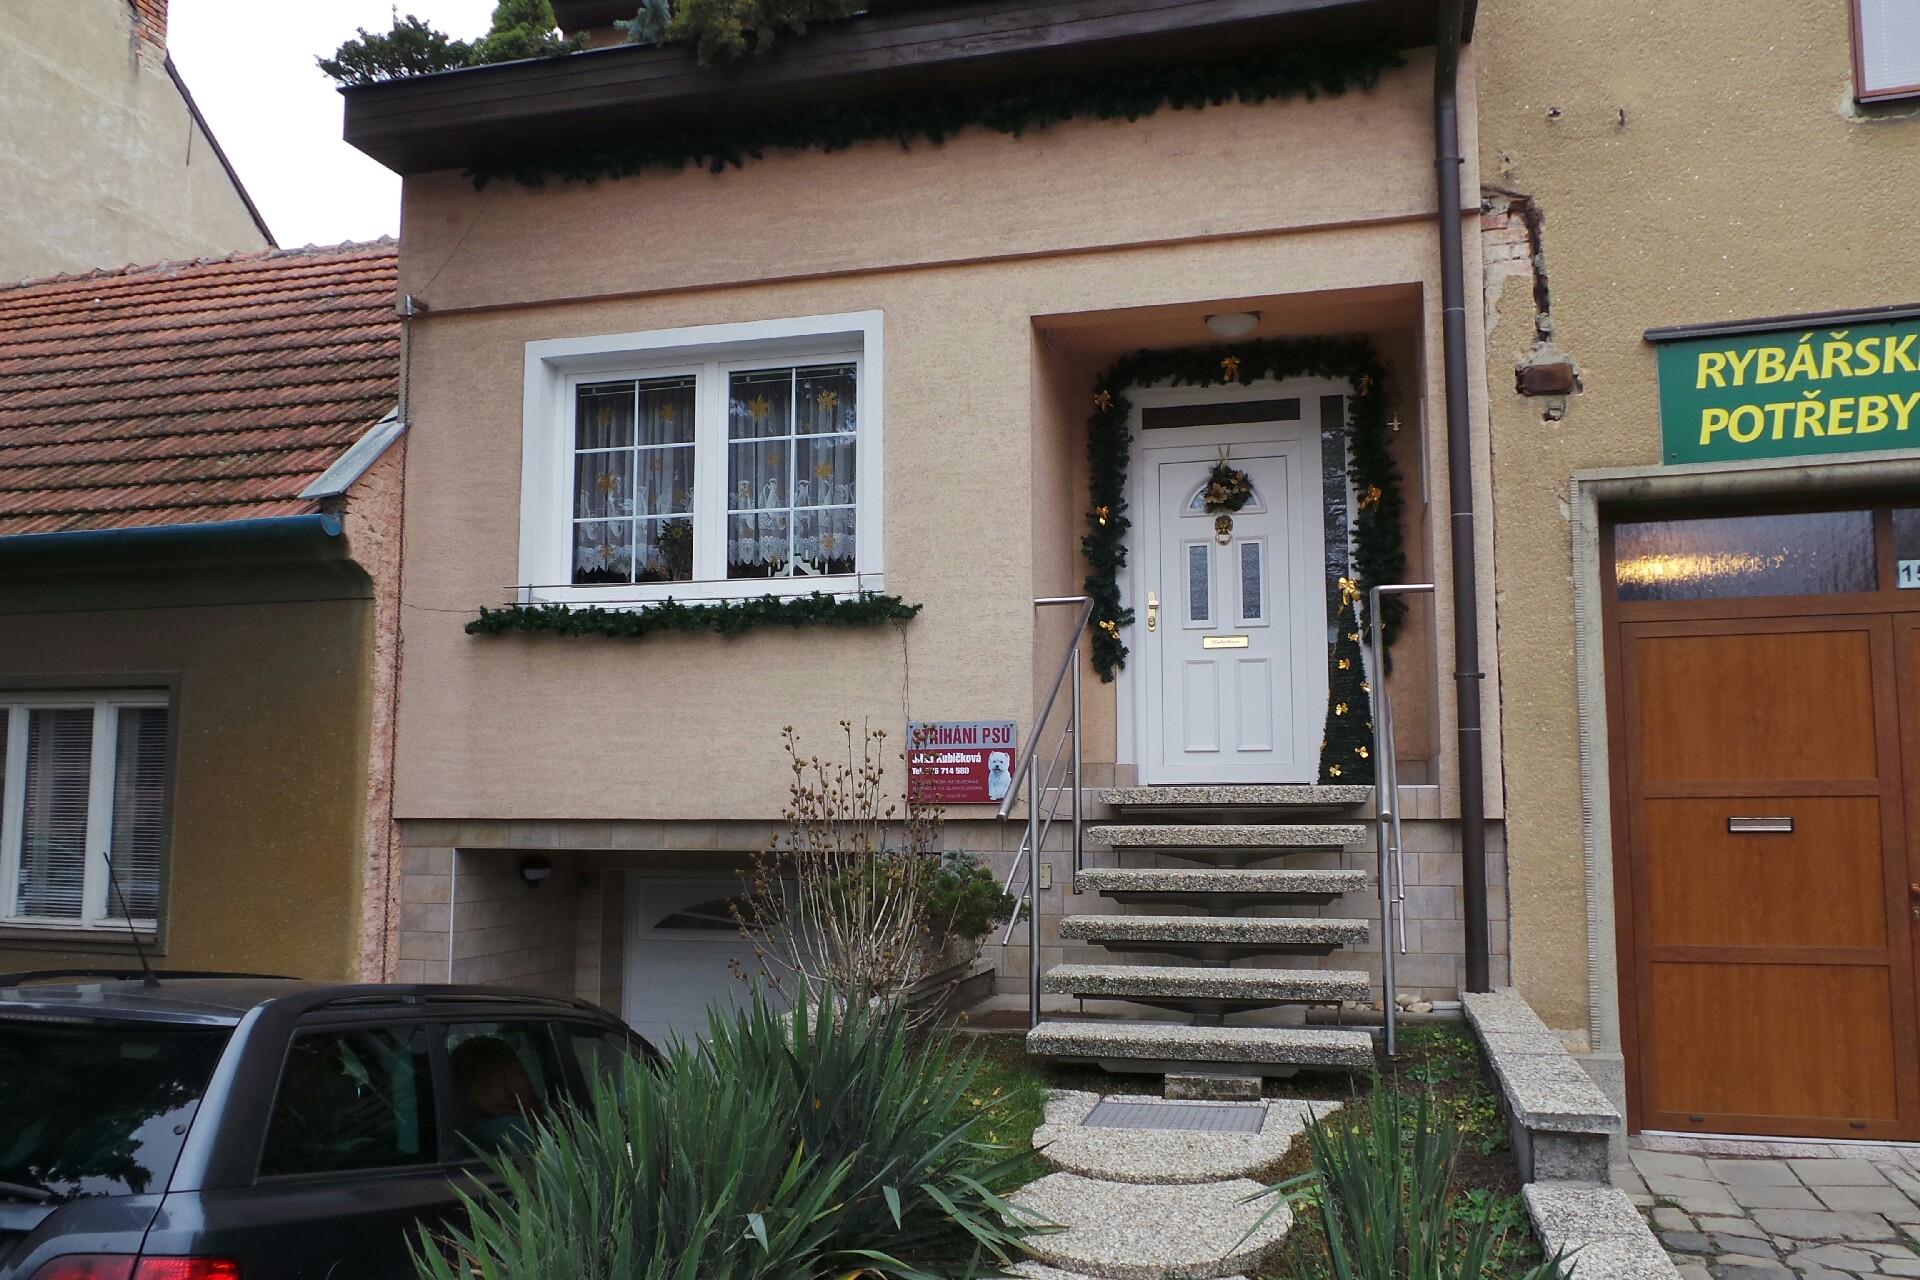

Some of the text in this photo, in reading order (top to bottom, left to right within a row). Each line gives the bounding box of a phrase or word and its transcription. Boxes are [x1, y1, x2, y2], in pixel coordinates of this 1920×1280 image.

[1695, 330, 1920, 389] RYBÁŘSK
[1699, 389, 1920, 446] POTŘEBY
[982, 724, 1010, 744] PSŮ
[940, 767, 954, 775] 714
[955, 766, 970, 775] 580
